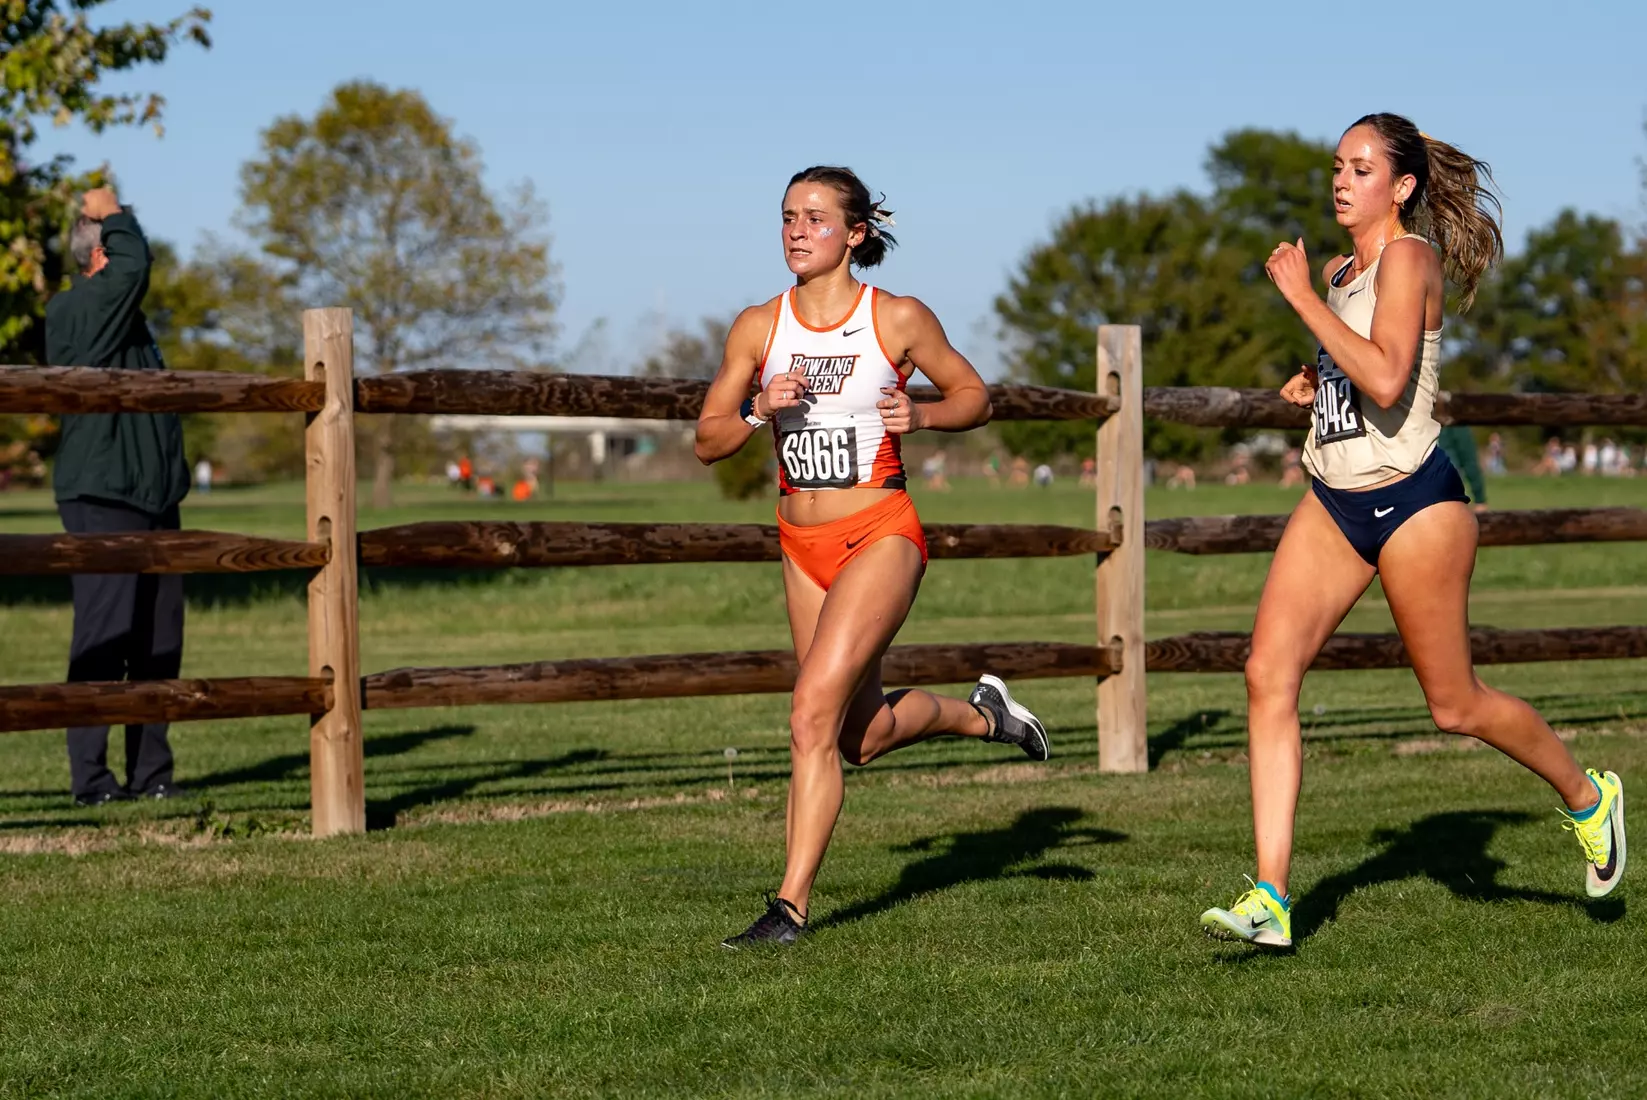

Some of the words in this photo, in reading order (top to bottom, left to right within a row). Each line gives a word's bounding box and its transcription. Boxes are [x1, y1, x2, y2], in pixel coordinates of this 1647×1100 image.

[790, 355, 856, 377] BOWLING
[803, 374, 845, 394] REEN
[782, 429, 851, 481] 6966
